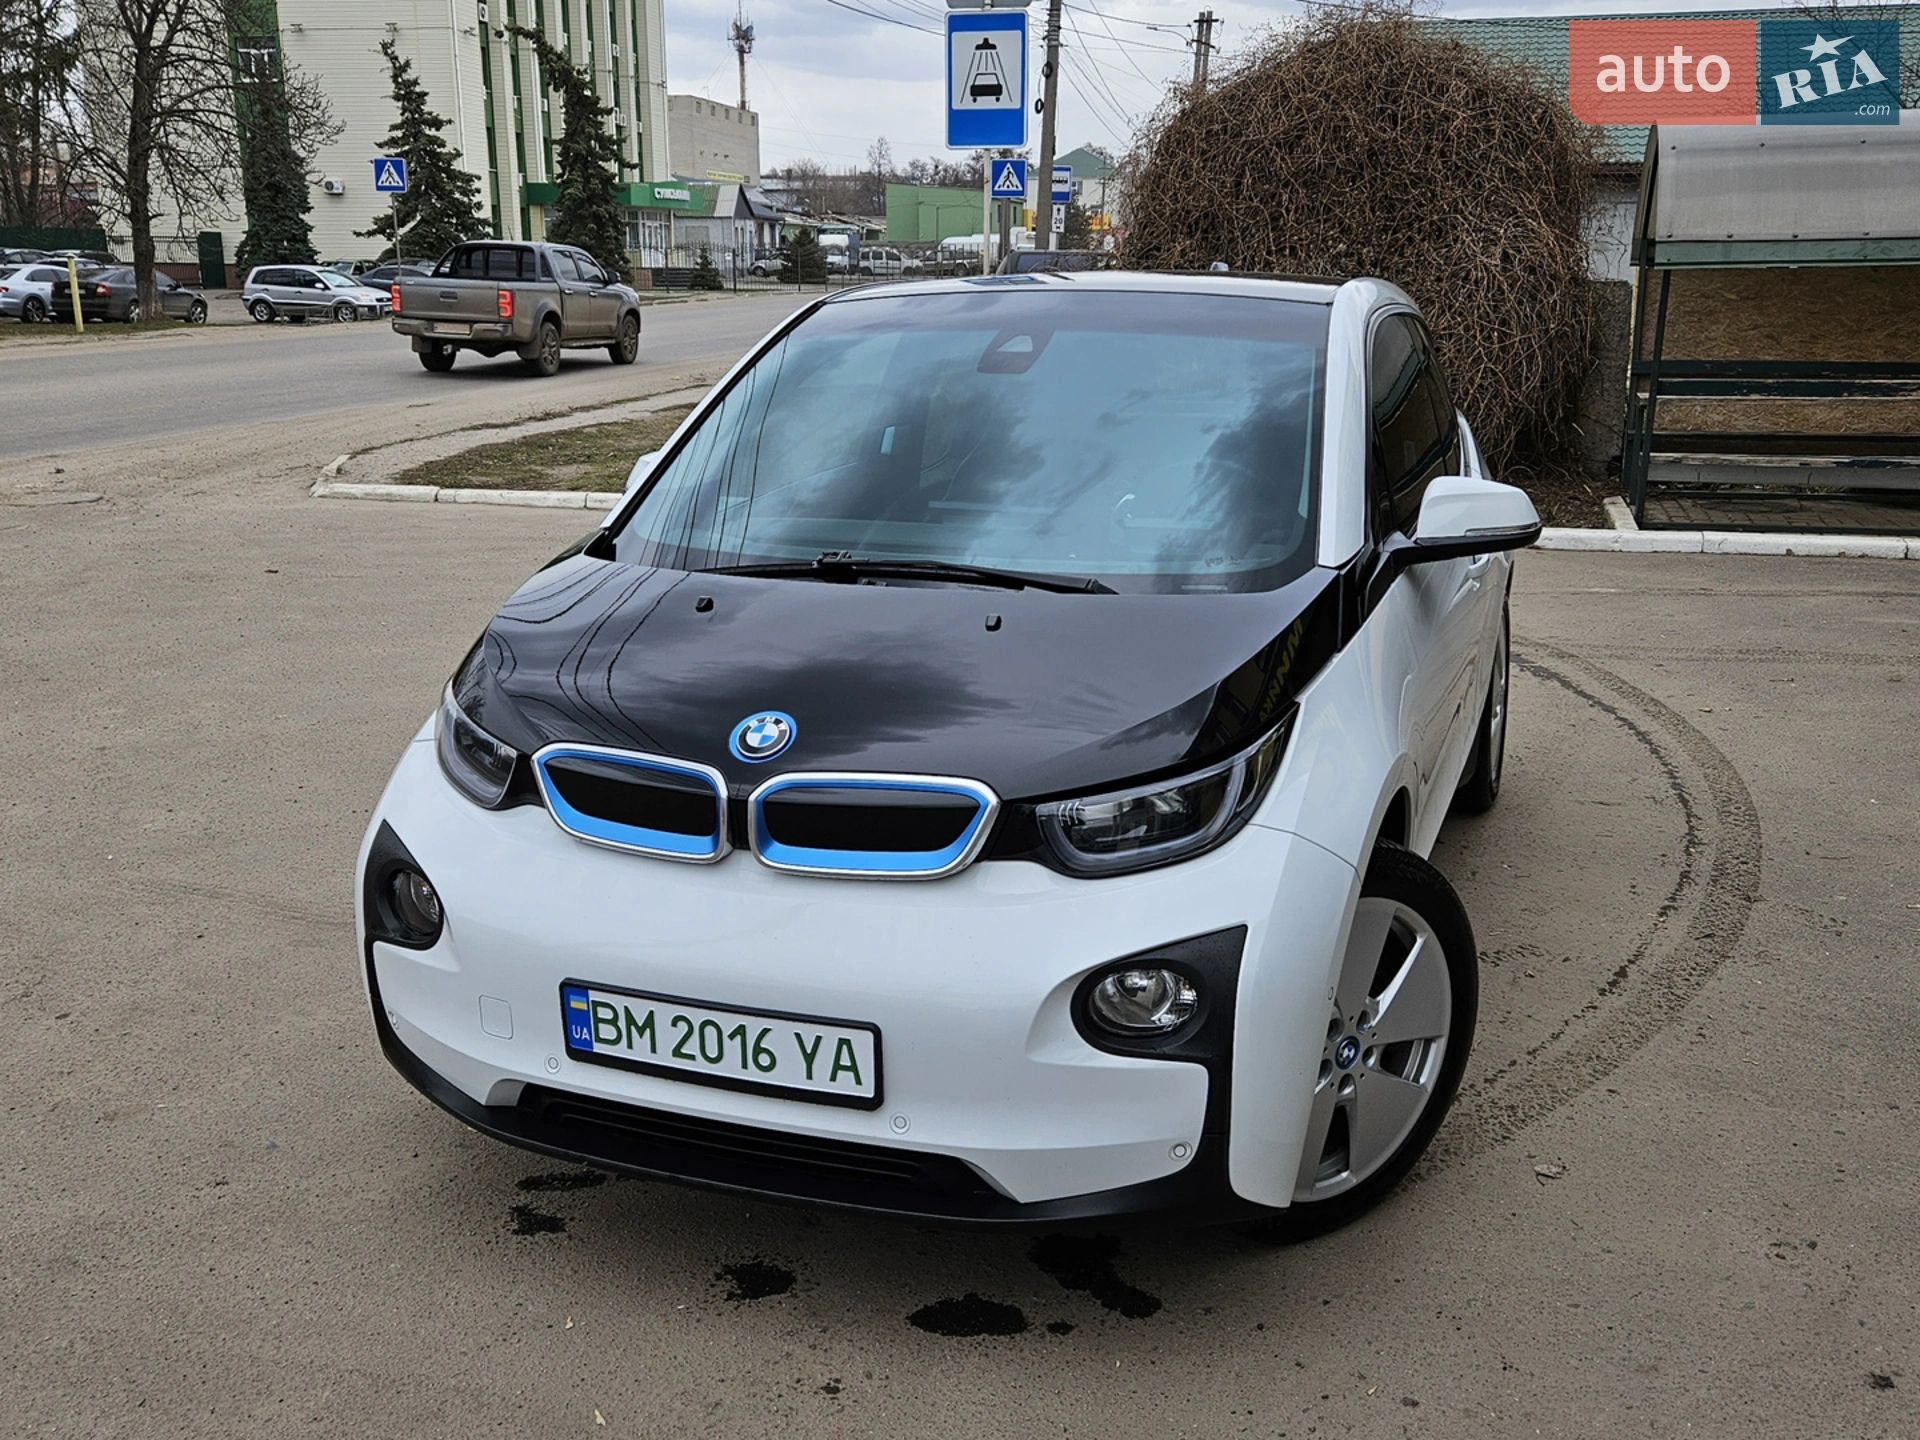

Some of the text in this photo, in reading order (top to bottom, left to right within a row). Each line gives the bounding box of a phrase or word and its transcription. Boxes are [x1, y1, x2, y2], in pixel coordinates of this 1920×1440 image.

[572, 1024, 590, 1042] UA
[670, 1014, 777, 1074] 2016
[794, 1031, 863, 1087] YA
